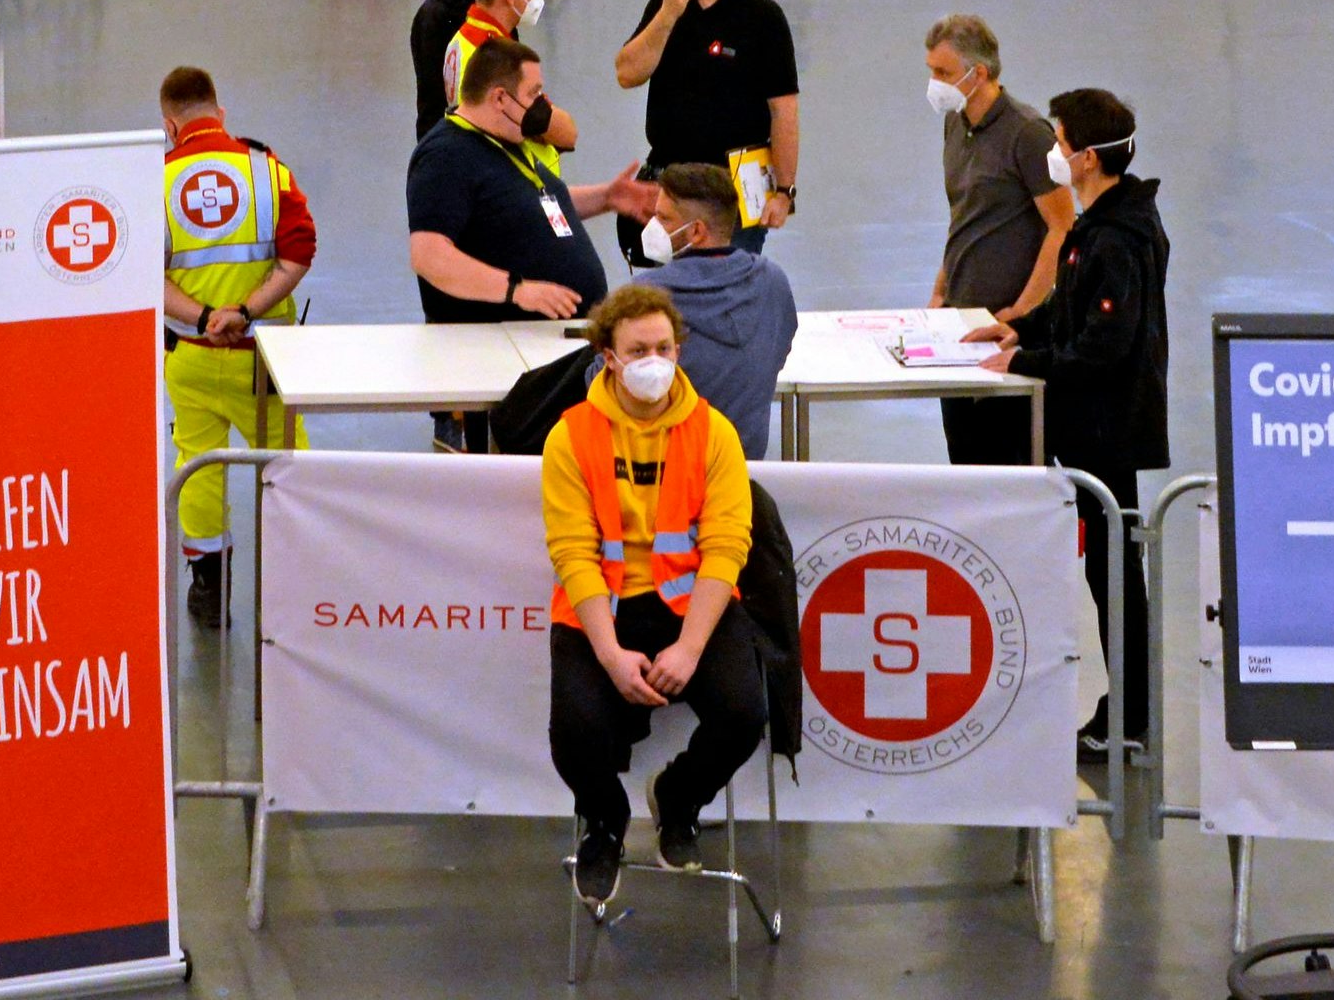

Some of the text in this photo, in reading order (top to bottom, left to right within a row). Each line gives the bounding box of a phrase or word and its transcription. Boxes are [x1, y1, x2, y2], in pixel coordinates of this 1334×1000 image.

[72, 222, 91, 247] S
[314, 602, 547, 632] SAMARITE
[844, 525, 996, 588] SAMARITER
[994, 606, 1018, 690] BUND
[873, 611, 920, 675] S
[1247, 655, 1273, 665] Stadt
[1247, 664, 1273, 674] Wien
[807, 715, 985, 767] ÖSTERREICHS
